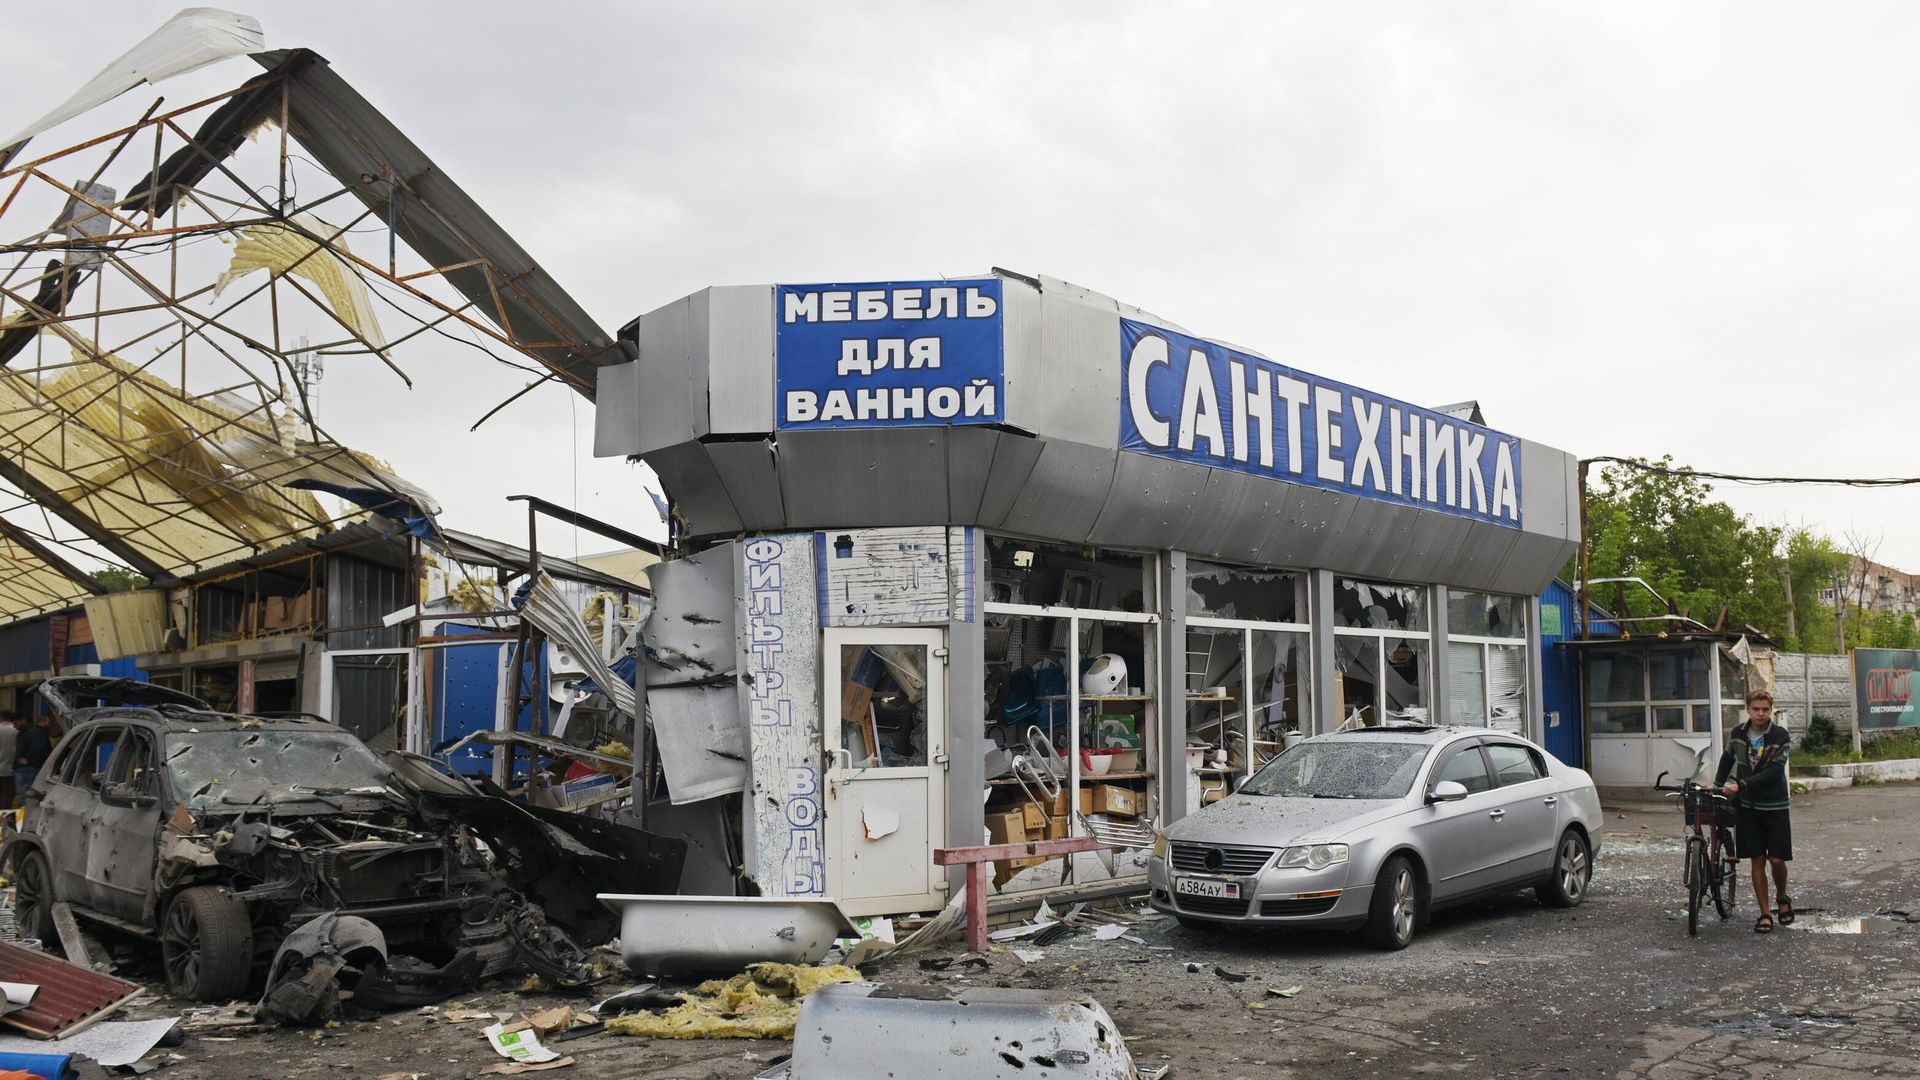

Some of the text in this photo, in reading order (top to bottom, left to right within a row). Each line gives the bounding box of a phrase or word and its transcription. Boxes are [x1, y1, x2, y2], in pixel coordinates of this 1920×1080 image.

[783, 287, 997, 323] МЕБЕЛЬ
[836, 337, 942, 376] ДЛЯ
[785, 378, 996, 423] ВАННОЙ
[1127, 334, 1519, 522] САНТЕХНИКА
[745, 538, 792, 727] ФИЛЬТРЫ
[782, 766, 824, 894] ВОДЫ
